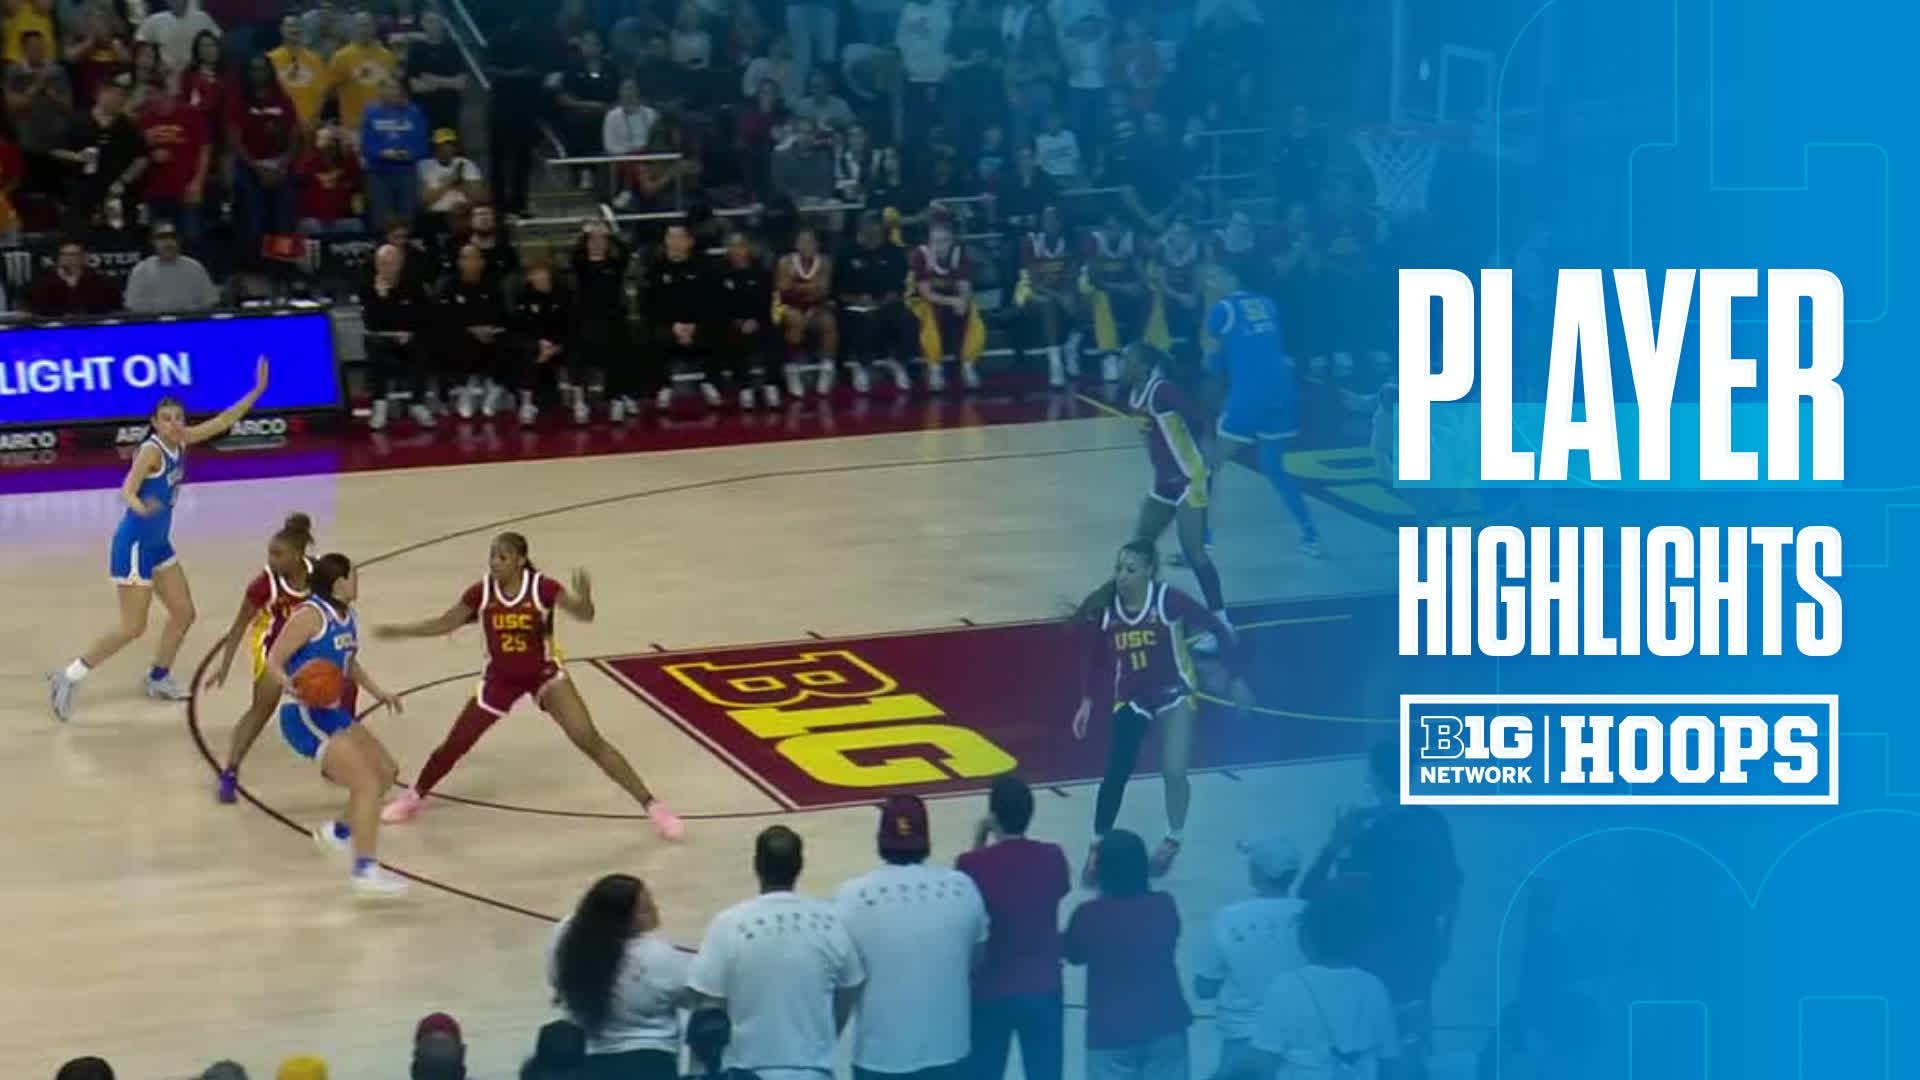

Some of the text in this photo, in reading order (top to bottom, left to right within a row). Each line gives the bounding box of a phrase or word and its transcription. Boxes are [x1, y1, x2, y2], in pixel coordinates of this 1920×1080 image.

[0, 352, 192, 395] LIGHT ON
[230, 418, 287, 436] ARCO
[492, 613, 533, 630] USC
[501, 633, 527, 652] 25
[1115, 630, 1157, 650] USC
[1130, 651, 1148, 671] 11
